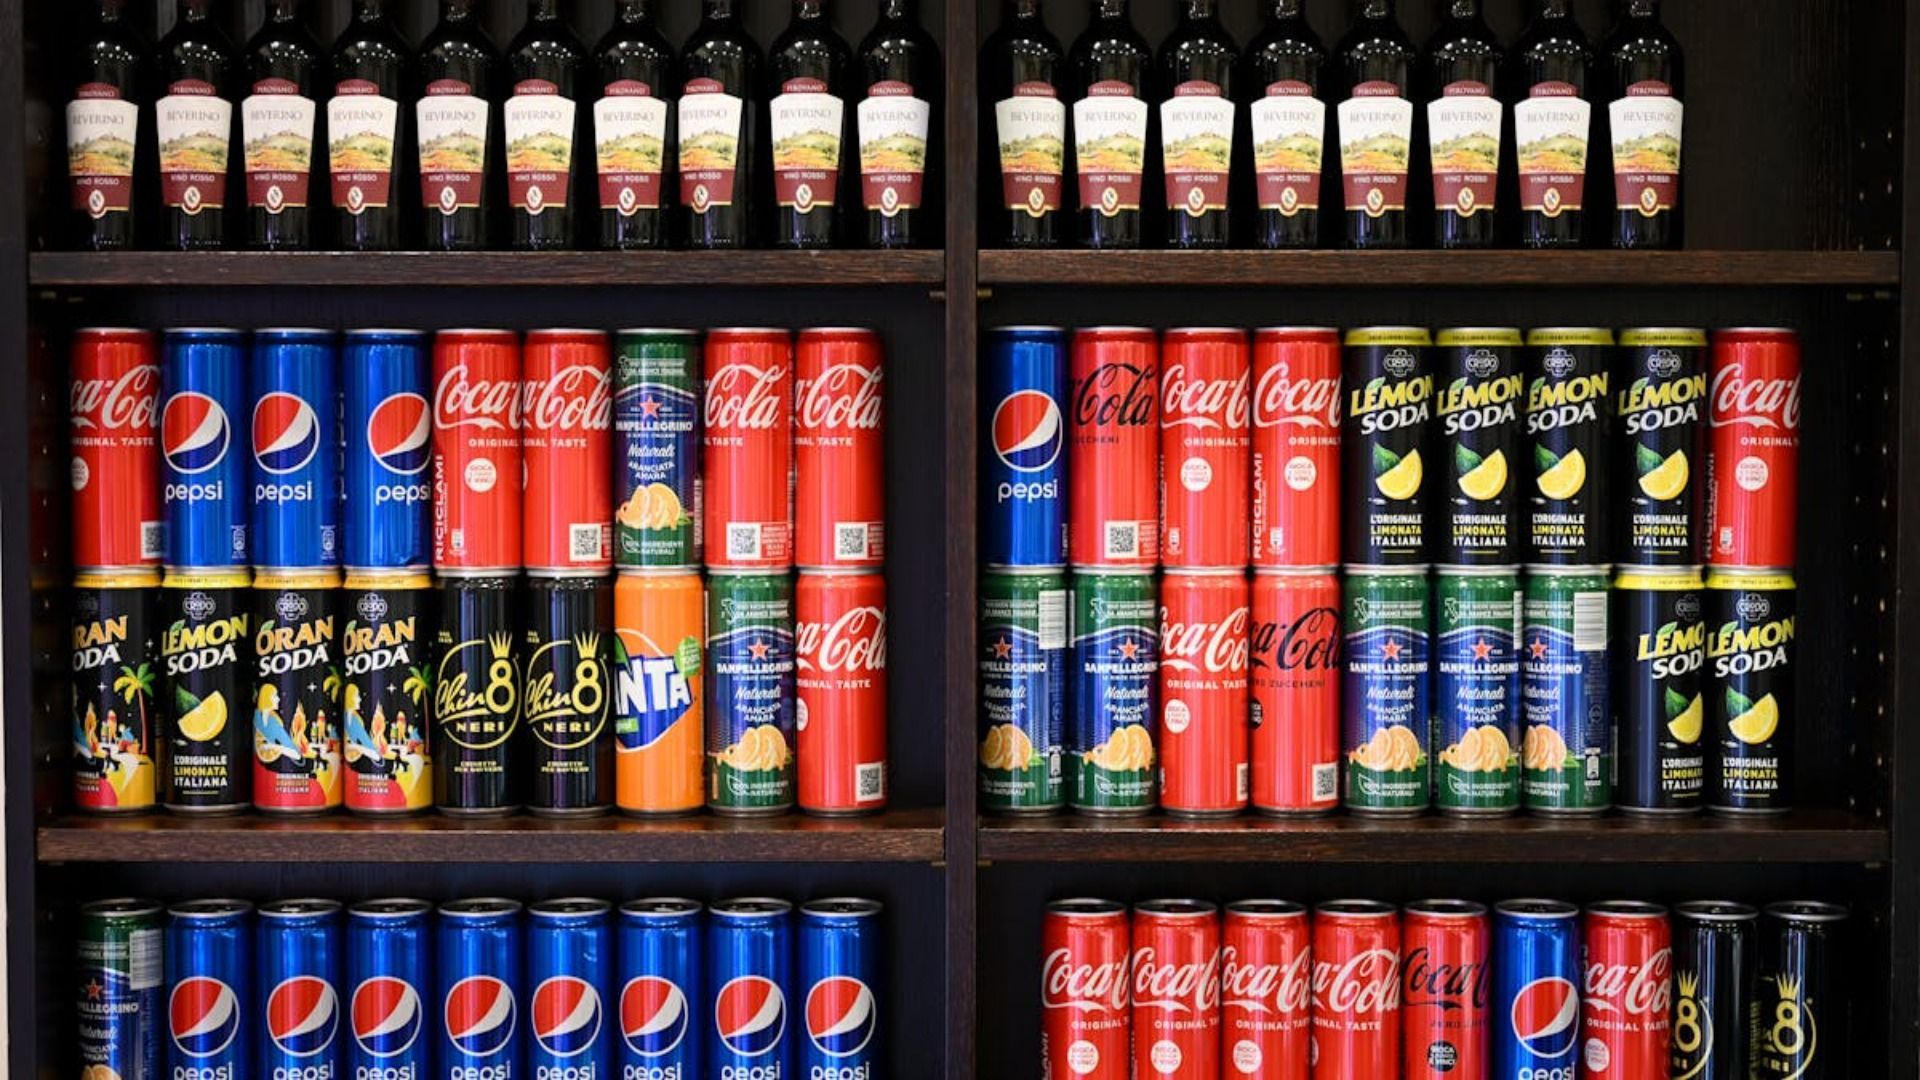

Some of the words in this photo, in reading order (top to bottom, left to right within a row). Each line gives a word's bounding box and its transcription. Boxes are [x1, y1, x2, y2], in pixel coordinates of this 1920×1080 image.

[73, 111, 125, 125] BEVERINO
[166, 109, 220, 122] BEVERINO
[251, 109, 303, 122] BEVERINO
[425, 110, 476, 123] BEVERINO
[512, 109, 562, 121] BEVERINO
[603, 110, 655, 122] BEVERINO
[780, 108, 831, 120] BEVERINO
[1010, 112, 1060, 122] BEVERINO
[1085, 111, 1136, 122] BEVERINO
[1172, 111, 1224, 122] BEVERINO
[1263, 111, 1316, 122] BEVERINO
[1350, 112, 1402, 123] BEVERINO
[1441, 112, 1493, 122] BEVERINO
[1527, 112, 1580, 122] BEVERINO
[1623, 111, 1676, 122] BEVERINO
[171, 174, 187, 182] VINO
[190, 174, 215, 182] ROSSO
[254, 174, 271, 182] VINO
[273, 174, 298, 182] ROSSO
[607, 175, 623, 184] VINO
[625, 175, 649, 183] ROSSO
[870, 175, 886, 183] VINO
[888, 174, 912, 183] ROSSO
[1089, 174, 1105, 183] VINO
[1108, 174, 1132, 183] ROSSO
[1175, 174, 1192, 183] VINO
[1195, 174, 1218, 183] ROSSO
[1267, 174, 1284, 183] VINO
[1287, 174, 1310, 183] ROSSO
[1353, 175, 1370, 184] VINO
[1373, 175, 1397, 184] ROSSO
[1531, 175, 1548, 184] VINO
[1550, 175, 1574, 184] ROSSO
[1351, 373, 1433, 416] LEMON
[1436, 372, 1523, 416] LEMON
[1528, 372, 1608, 413] EMON
[1619, 372, 1706, 416] LEMON
[1361, 402, 1429, 434] SODA
[1445, 402, 1515, 435] SODA
[1528, 402, 1596, 434] SODA
[1626, 403, 1698, 434] SODA
[121, 438, 154, 446] TASTE
[552, 439, 587, 448] TASTE
[712, 437, 743, 446] TASTE
[818, 437, 852, 446] TASTE
[1184, 438, 1237, 447] ORIGINAL
[1289, 437, 1337, 445] ORIGINAL
[1741, 437, 1792, 445] ORIGINAL
[628, 462, 675, 472] ARANCIATA
[165, 481, 223, 505] pepsi
[255, 481, 312, 505] pepsi
[376, 481, 431, 506] pepsi
[999, 479, 1057, 503] pepsi
[435, 455, 444, 560] RICICLAMI
[1254, 453, 1262, 558] RICICLAMI
[1371, 514, 1421, 524] L'ORIGINALE
[1453, 514, 1506, 524] L'ORIGINALE
[1533, 514, 1584, 524] L'ORIGINALE
[1633, 514, 1687, 524] L'ORIGINALE
[1371, 525, 1421, 534] LIMONATA
[1453, 525, 1506, 534] LIMONATA
[1533, 525, 1584, 534] LIMONATA
[1633, 525, 1687, 534] LIMONATA
[1371, 536, 1422, 545] ITALIANA
[1453, 536, 1506, 545] ITALIANA
[1533, 536, 1585, 545] ITALIANA
[1633, 536, 1687, 545] ITALIANA
[75, 615, 127, 649] RAN
[162, 613, 248, 656] LEMON
[256, 616, 333, 655] ORAN
[344, 616, 416, 655] ORAN
[1707, 616, 1795, 658] LEMON
[1637, 621, 1704, 660] LEMO
[73, 644, 121, 671] ODA
[167, 644, 237, 675] SODA
[259, 644, 329, 677] SODA
[345, 645, 410, 676] SODA
[1715, 646, 1787, 677] SODA
[1350, 662, 1427, 673] SANPELLEGRINO
[1440, 662, 1518, 673] SANPELLEGRINO
[616, 658, 690, 715] NTA
[837, 679, 870, 688] TASTE
[1167, 679, 1218, 689] ORIGINAL
[1368, 704, 1414, 714] ARANCIATA
[1457, 704, 1504, 714] ARANCIATA
[456, 722, 504, 732] NERI
[544, 722, 590, 732] NERI
[174, 755, 227, 765] L'ORIGINALE
[1723, 757, 1778, 767] L'ORIGINALE
[174, 766, 227, 776] LIMONATA
[1724, 768, 1778, 778] LIMONATA
[174, 777, 228, 786] ITALIANA
[1724, 779, 1778, 789] ITALIANA
[1072, 1018, 1121, 1029] ORIGINAL
[1155, 1020, 1206, 1030] ORIGINAL
[1236, 1020, 1289, 1030] ORIGINAL
[1347, 1021, 1381, 1031] TASTE
[1587, 1020, 1638, 1031] ORIGINAL
